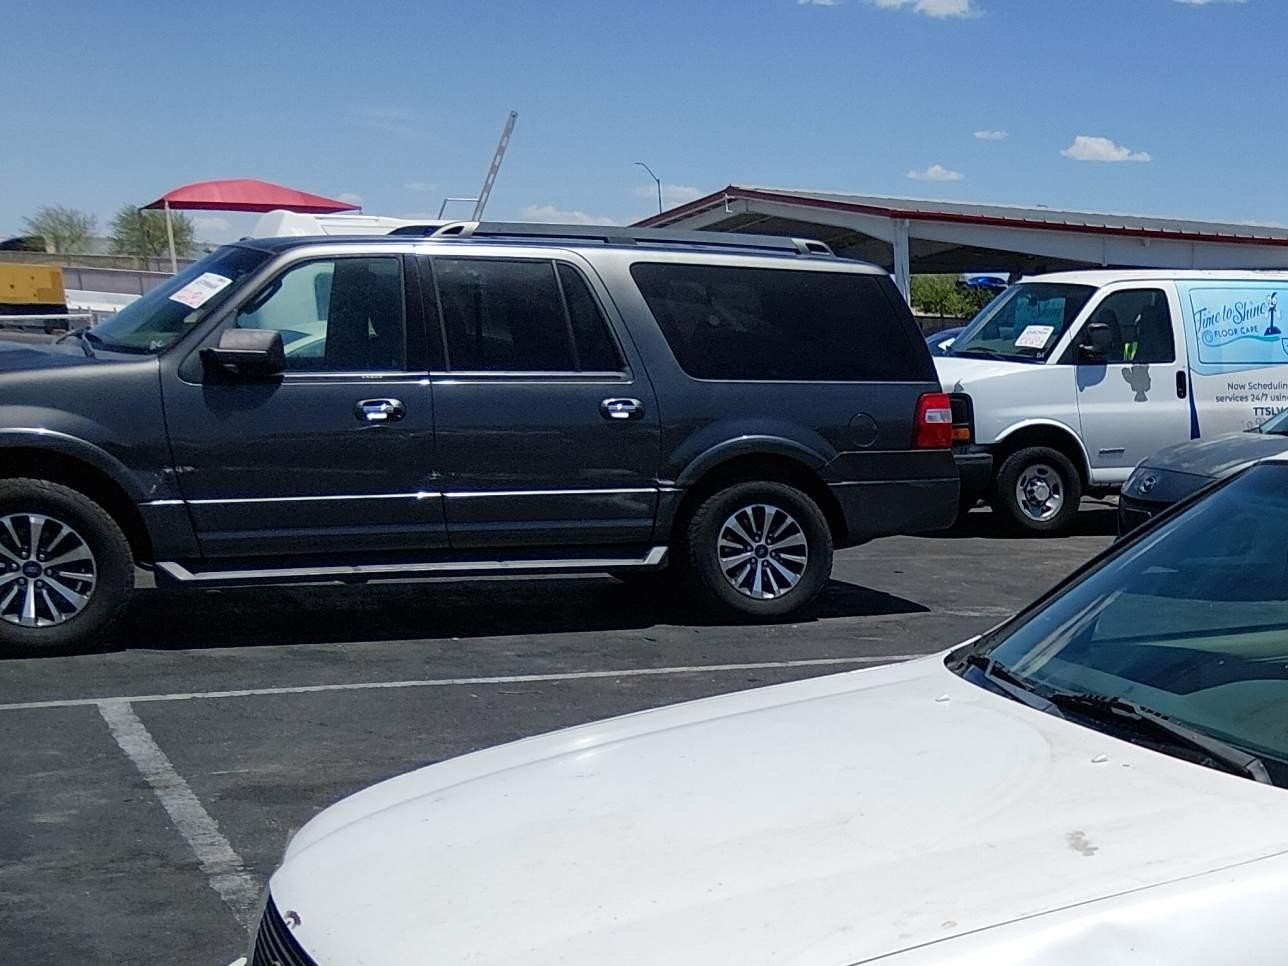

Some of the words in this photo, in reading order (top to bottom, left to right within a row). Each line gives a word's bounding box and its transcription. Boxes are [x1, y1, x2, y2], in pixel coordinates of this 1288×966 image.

[1194, 307, 1220, 333] Time
[1222, 305, 1233, 321] to
[1233, 301, 1268, 325] Shine
[1227, 382, 1246, 391] Now
[1215, 394, 1249, 402] services
[1250, 394, 1268, 402] 24/7
